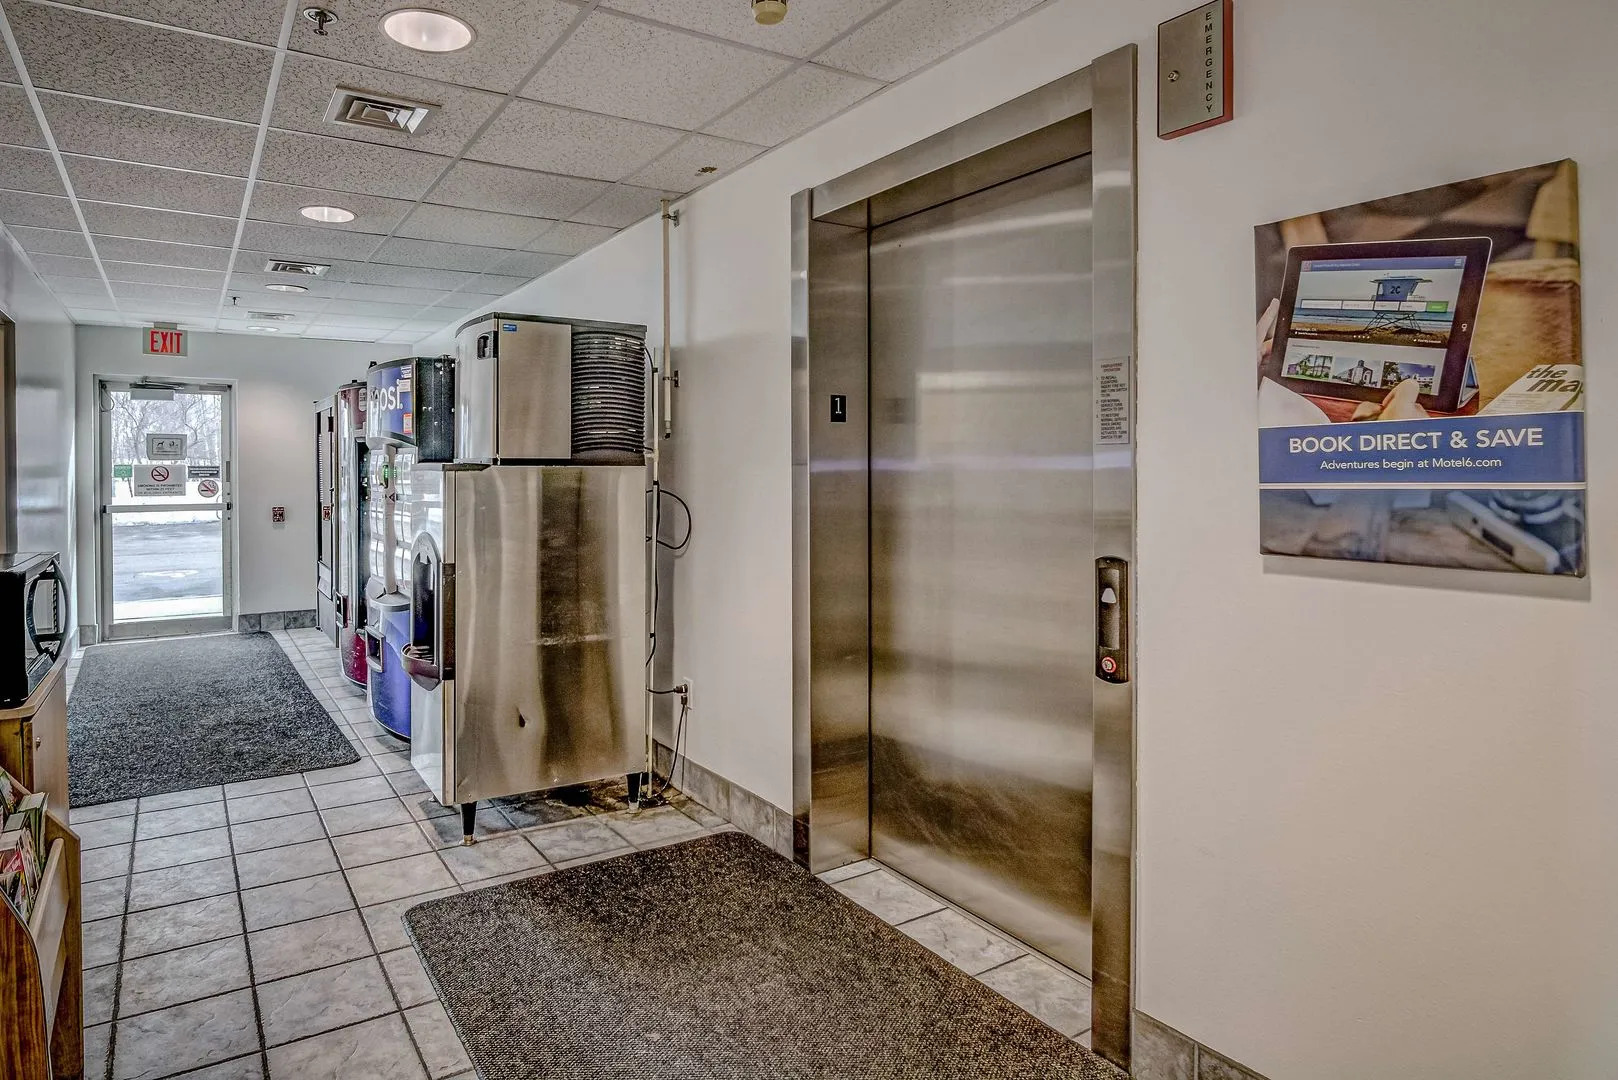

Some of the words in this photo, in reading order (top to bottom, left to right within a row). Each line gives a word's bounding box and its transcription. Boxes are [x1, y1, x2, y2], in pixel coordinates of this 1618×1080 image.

[1204, 11, 1213, 113] EMERGENCY
[1389, 285, 1401, 295] 2C
[150, 330, 183, 354] EXIT
[1526, 364, 1568, 379] the
[834, 397, 842, 414] 1
[1289, 435, 1353, 453] BOOK
[1359, 431, 1442, 451] DIRECT
[1449, 430, 1468, 448] &
[1476, 427, 1544, 448] SAVE
[1320, 460, 1380, 470] Adventures
[1382, 458, 1414, 471] begin
[1417, 459, 1429, 468] at
[1432, 457, 1502, 468] Motel6.com
